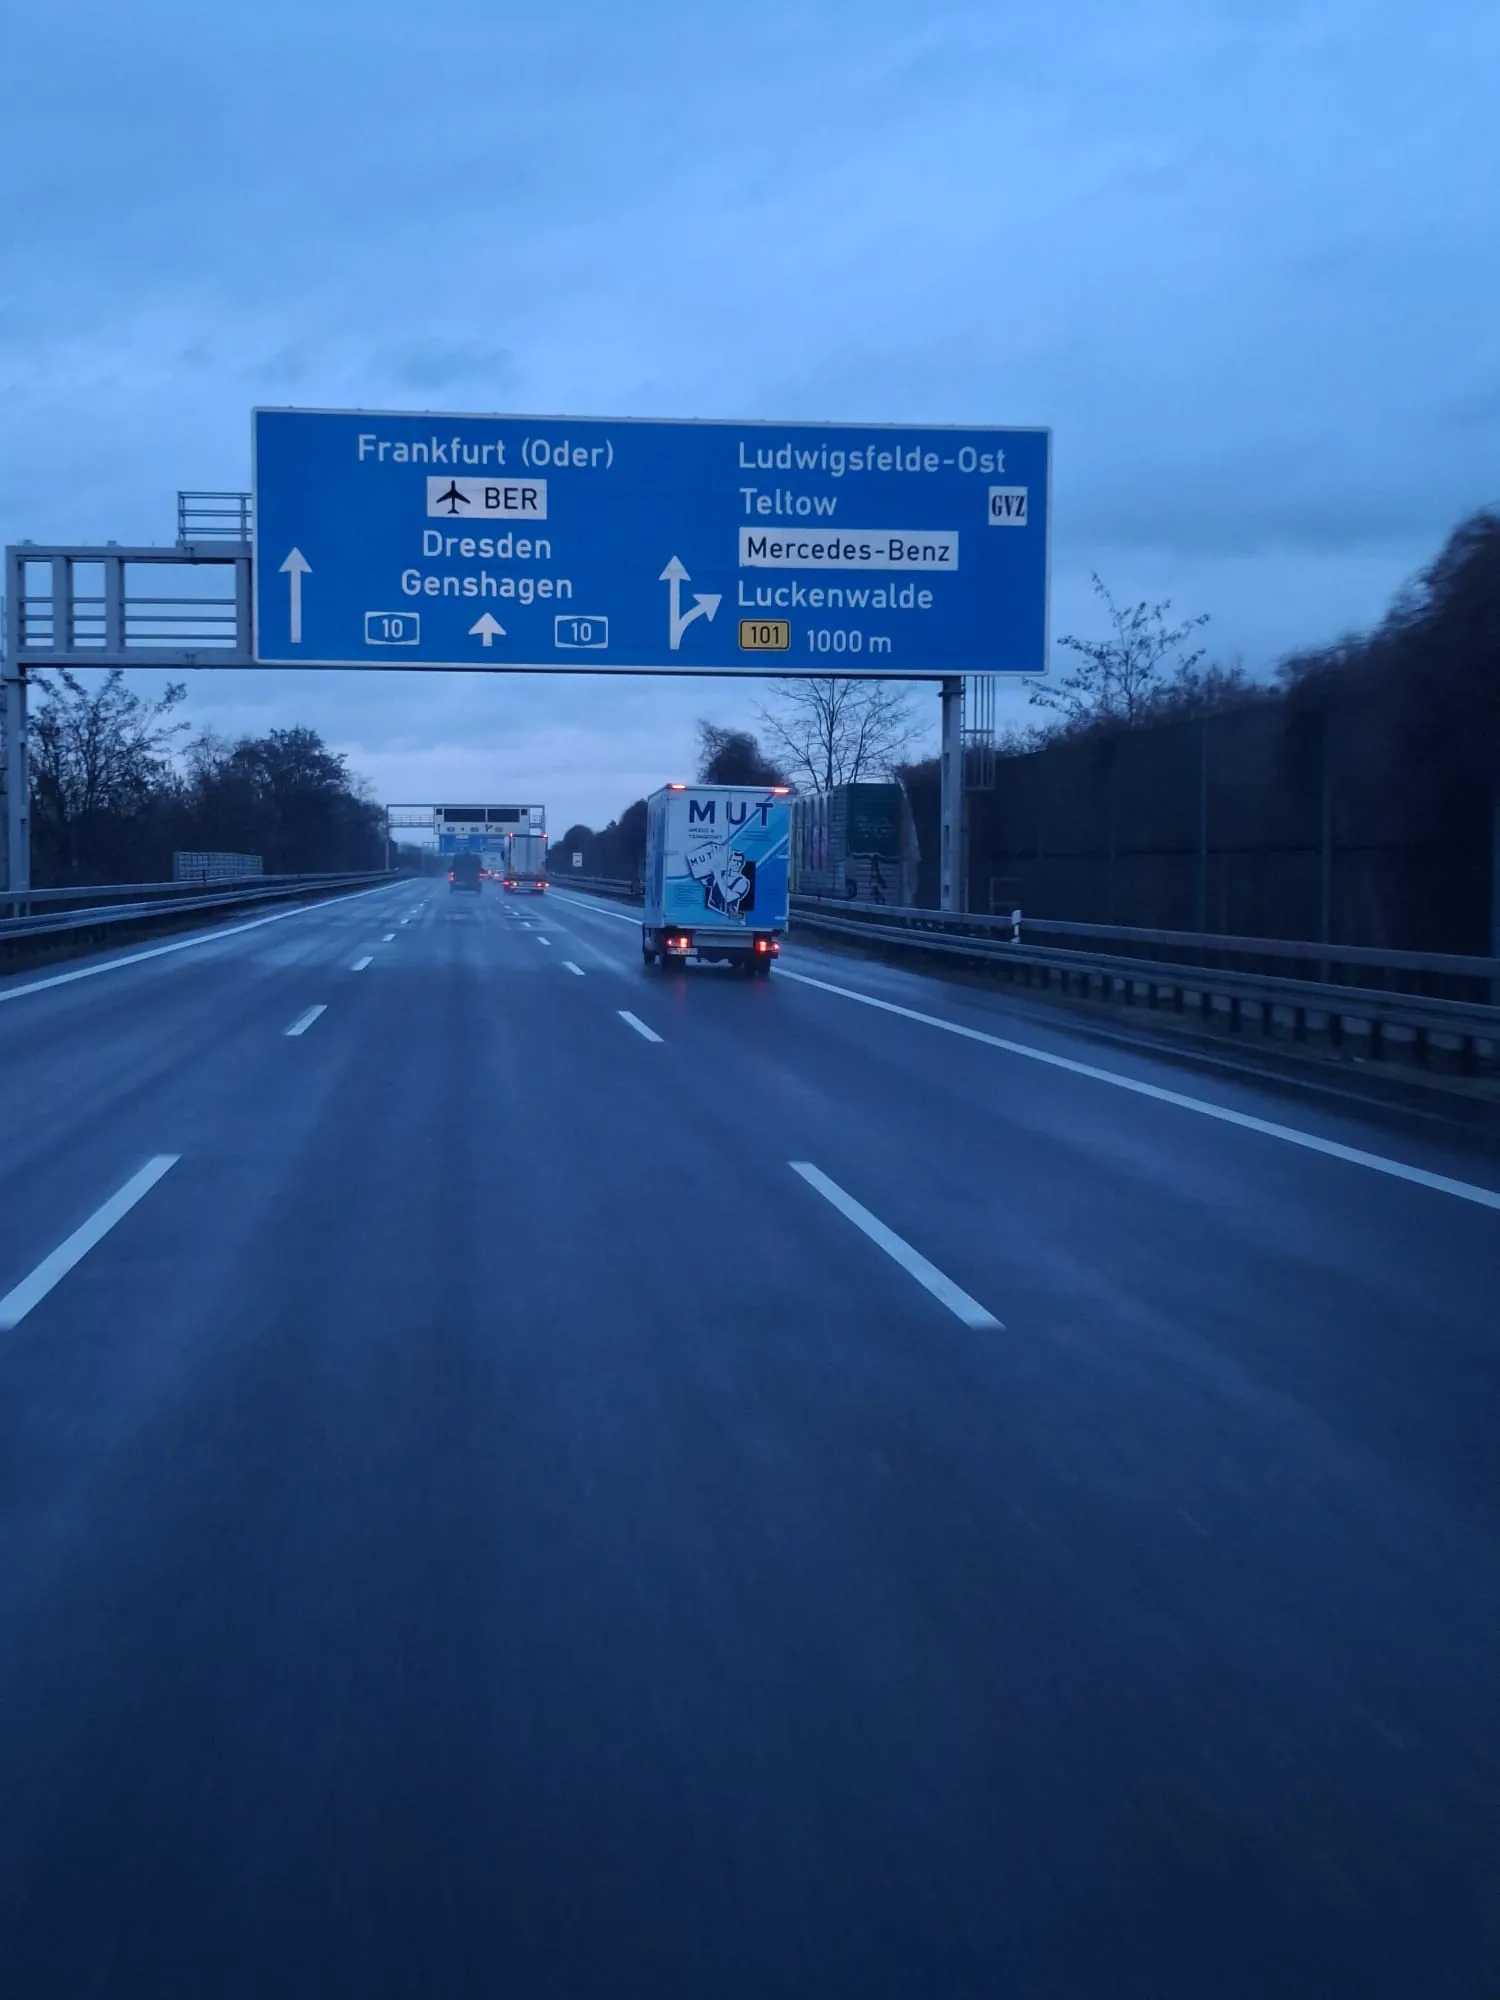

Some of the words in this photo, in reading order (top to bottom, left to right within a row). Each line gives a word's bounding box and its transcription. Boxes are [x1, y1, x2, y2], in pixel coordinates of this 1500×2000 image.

[358, 434, 506, 465] Frankfurt
[521, 437, 615, 469] (Oder)
[738, 441, 1006, 477] Ludwigsfelde-Ost
[484, 486, 538, 511] BER
[739, 487, 837, 516] Teltow
[991, 494, 1026, 518] GVZ
[423, 530, 552, 559] Dresden
[748, 536, 951, 563] Mercedes-Benz
[401, 569, 573, 605] Genshagen
[738, 580, 934, 610] Luckenwalde
[381, 618, 404, 639] 10
[570, 622, 592, 643] 10
[750, 625, 780, 645] 101
[807, 629, 862, 653] 1000
[869, 636, 892, 653] m
[689, 799, 774, 826] MUT
[690, 851, 712, 866] MUT
